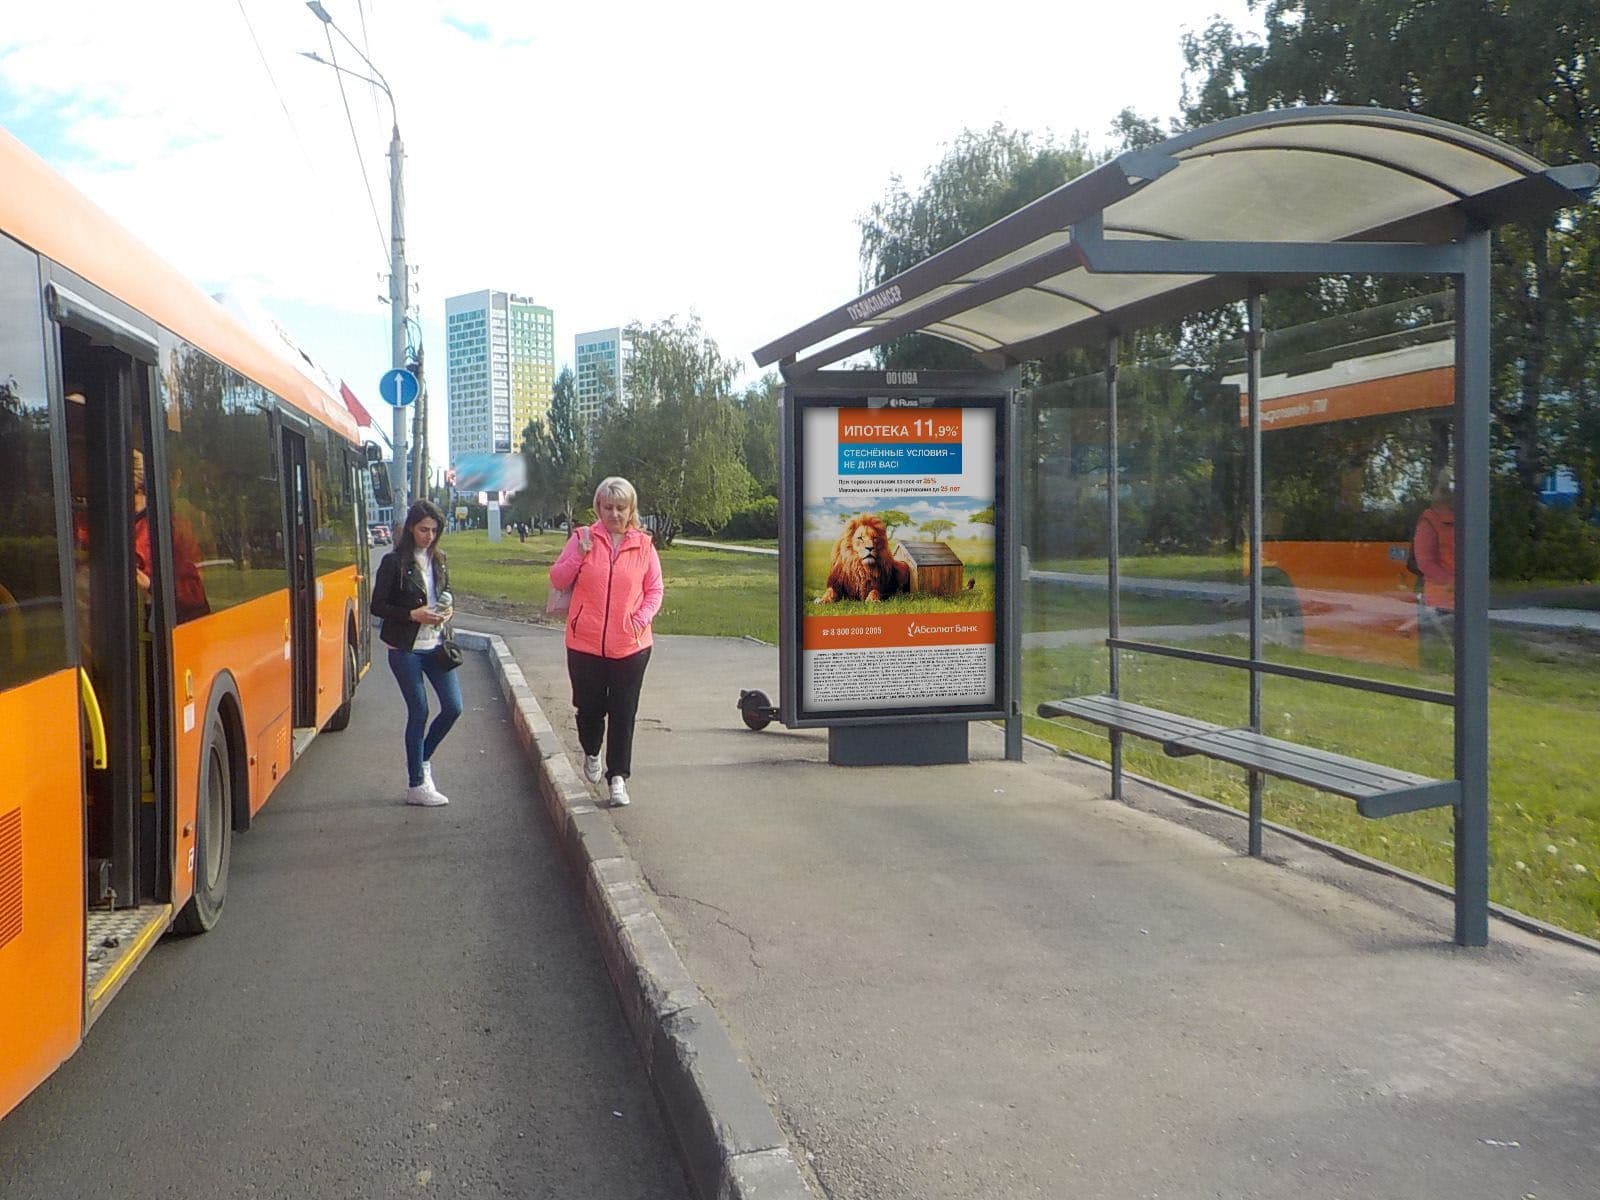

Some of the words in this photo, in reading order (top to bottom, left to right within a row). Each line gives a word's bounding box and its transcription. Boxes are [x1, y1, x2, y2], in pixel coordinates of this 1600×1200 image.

[844, 425, 909, 437] ИПОТЕКА
[843, 447, 904, 457] СТЕСНЁННЫЕ
[906, 449, 948, 457] УСЛОВИЯ
[843, 461, 856, 469] НЕ
[857, 461, 877, 470] ДЛЯ
[879, 460, 899, 469] ВАС!
[850, 626, 864, 635] 200
[865, 626, 882, 635] 2005
[914, 623, 954, 635] Абсолют
[955, 622, 978, 633] Банк
